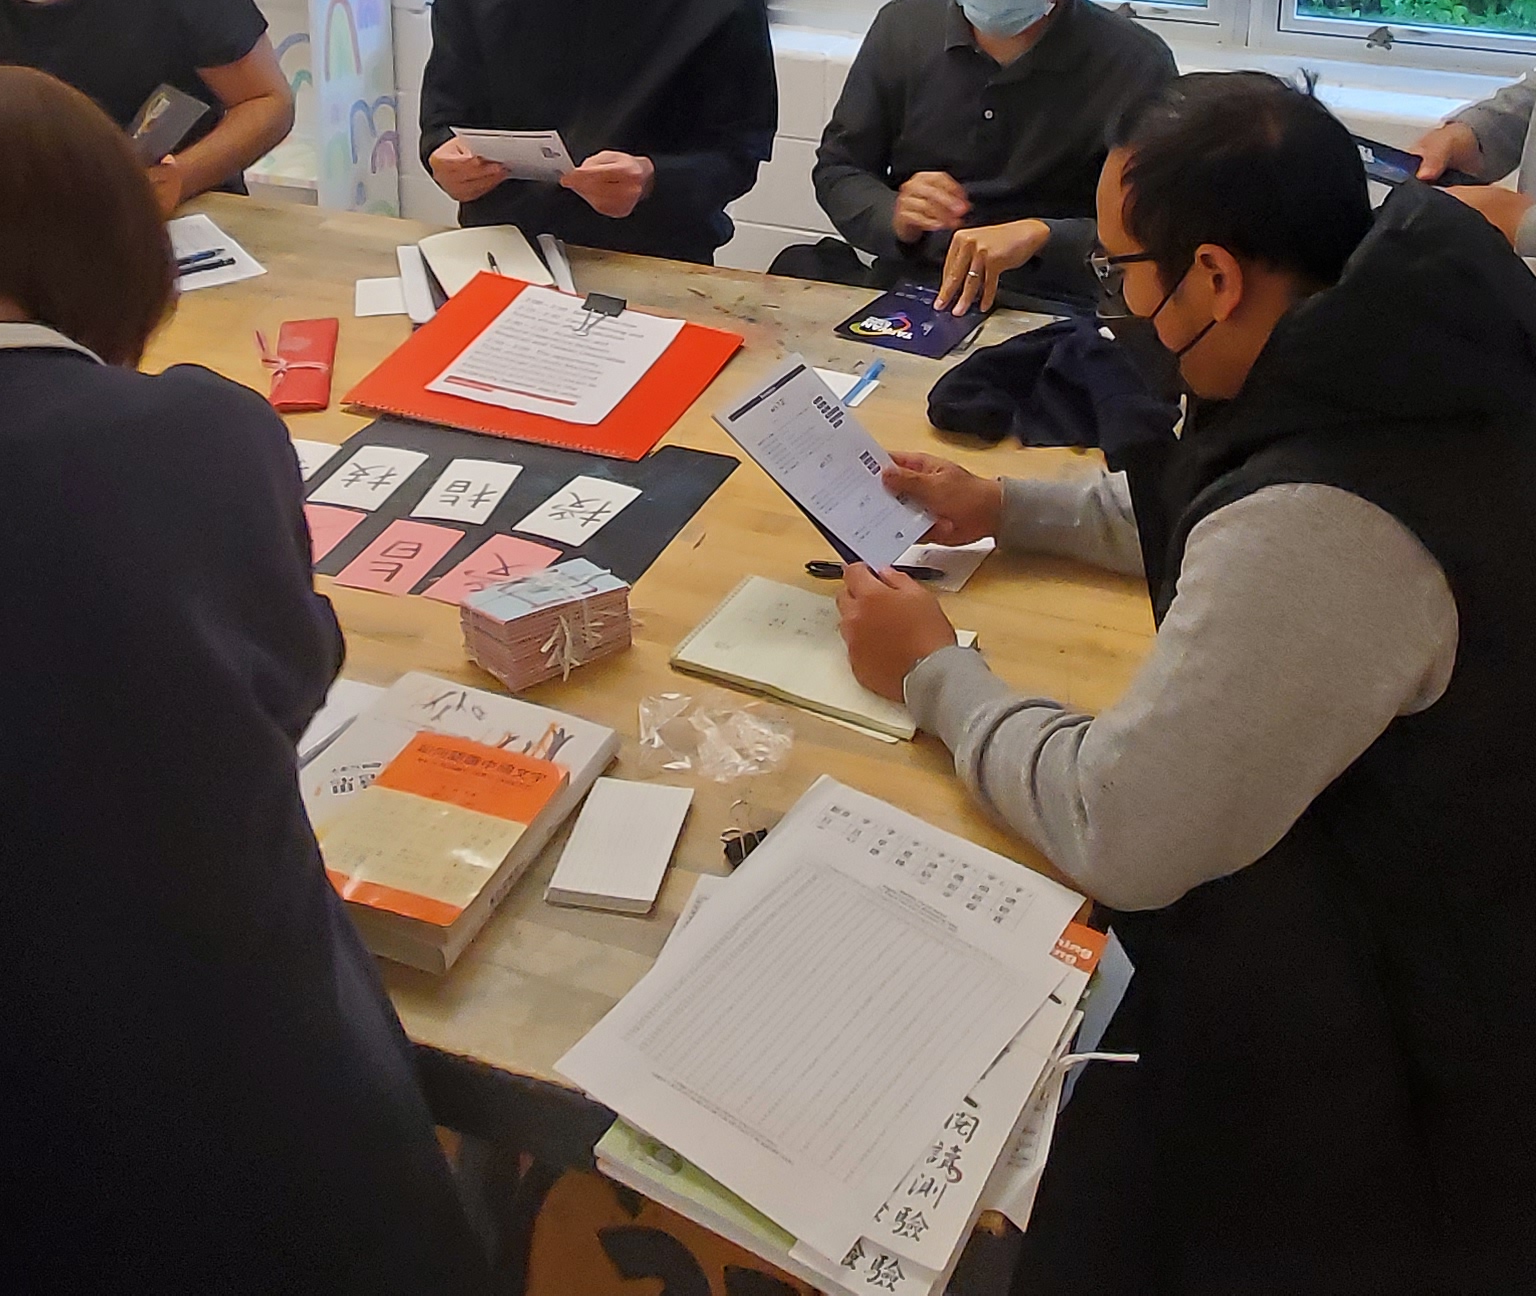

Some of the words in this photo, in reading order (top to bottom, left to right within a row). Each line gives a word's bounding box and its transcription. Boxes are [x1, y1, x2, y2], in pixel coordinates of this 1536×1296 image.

[340, 460, 397, 491] 技
[439, 479, 499, 509] 指
[368, 540, 422, 583] 旨
